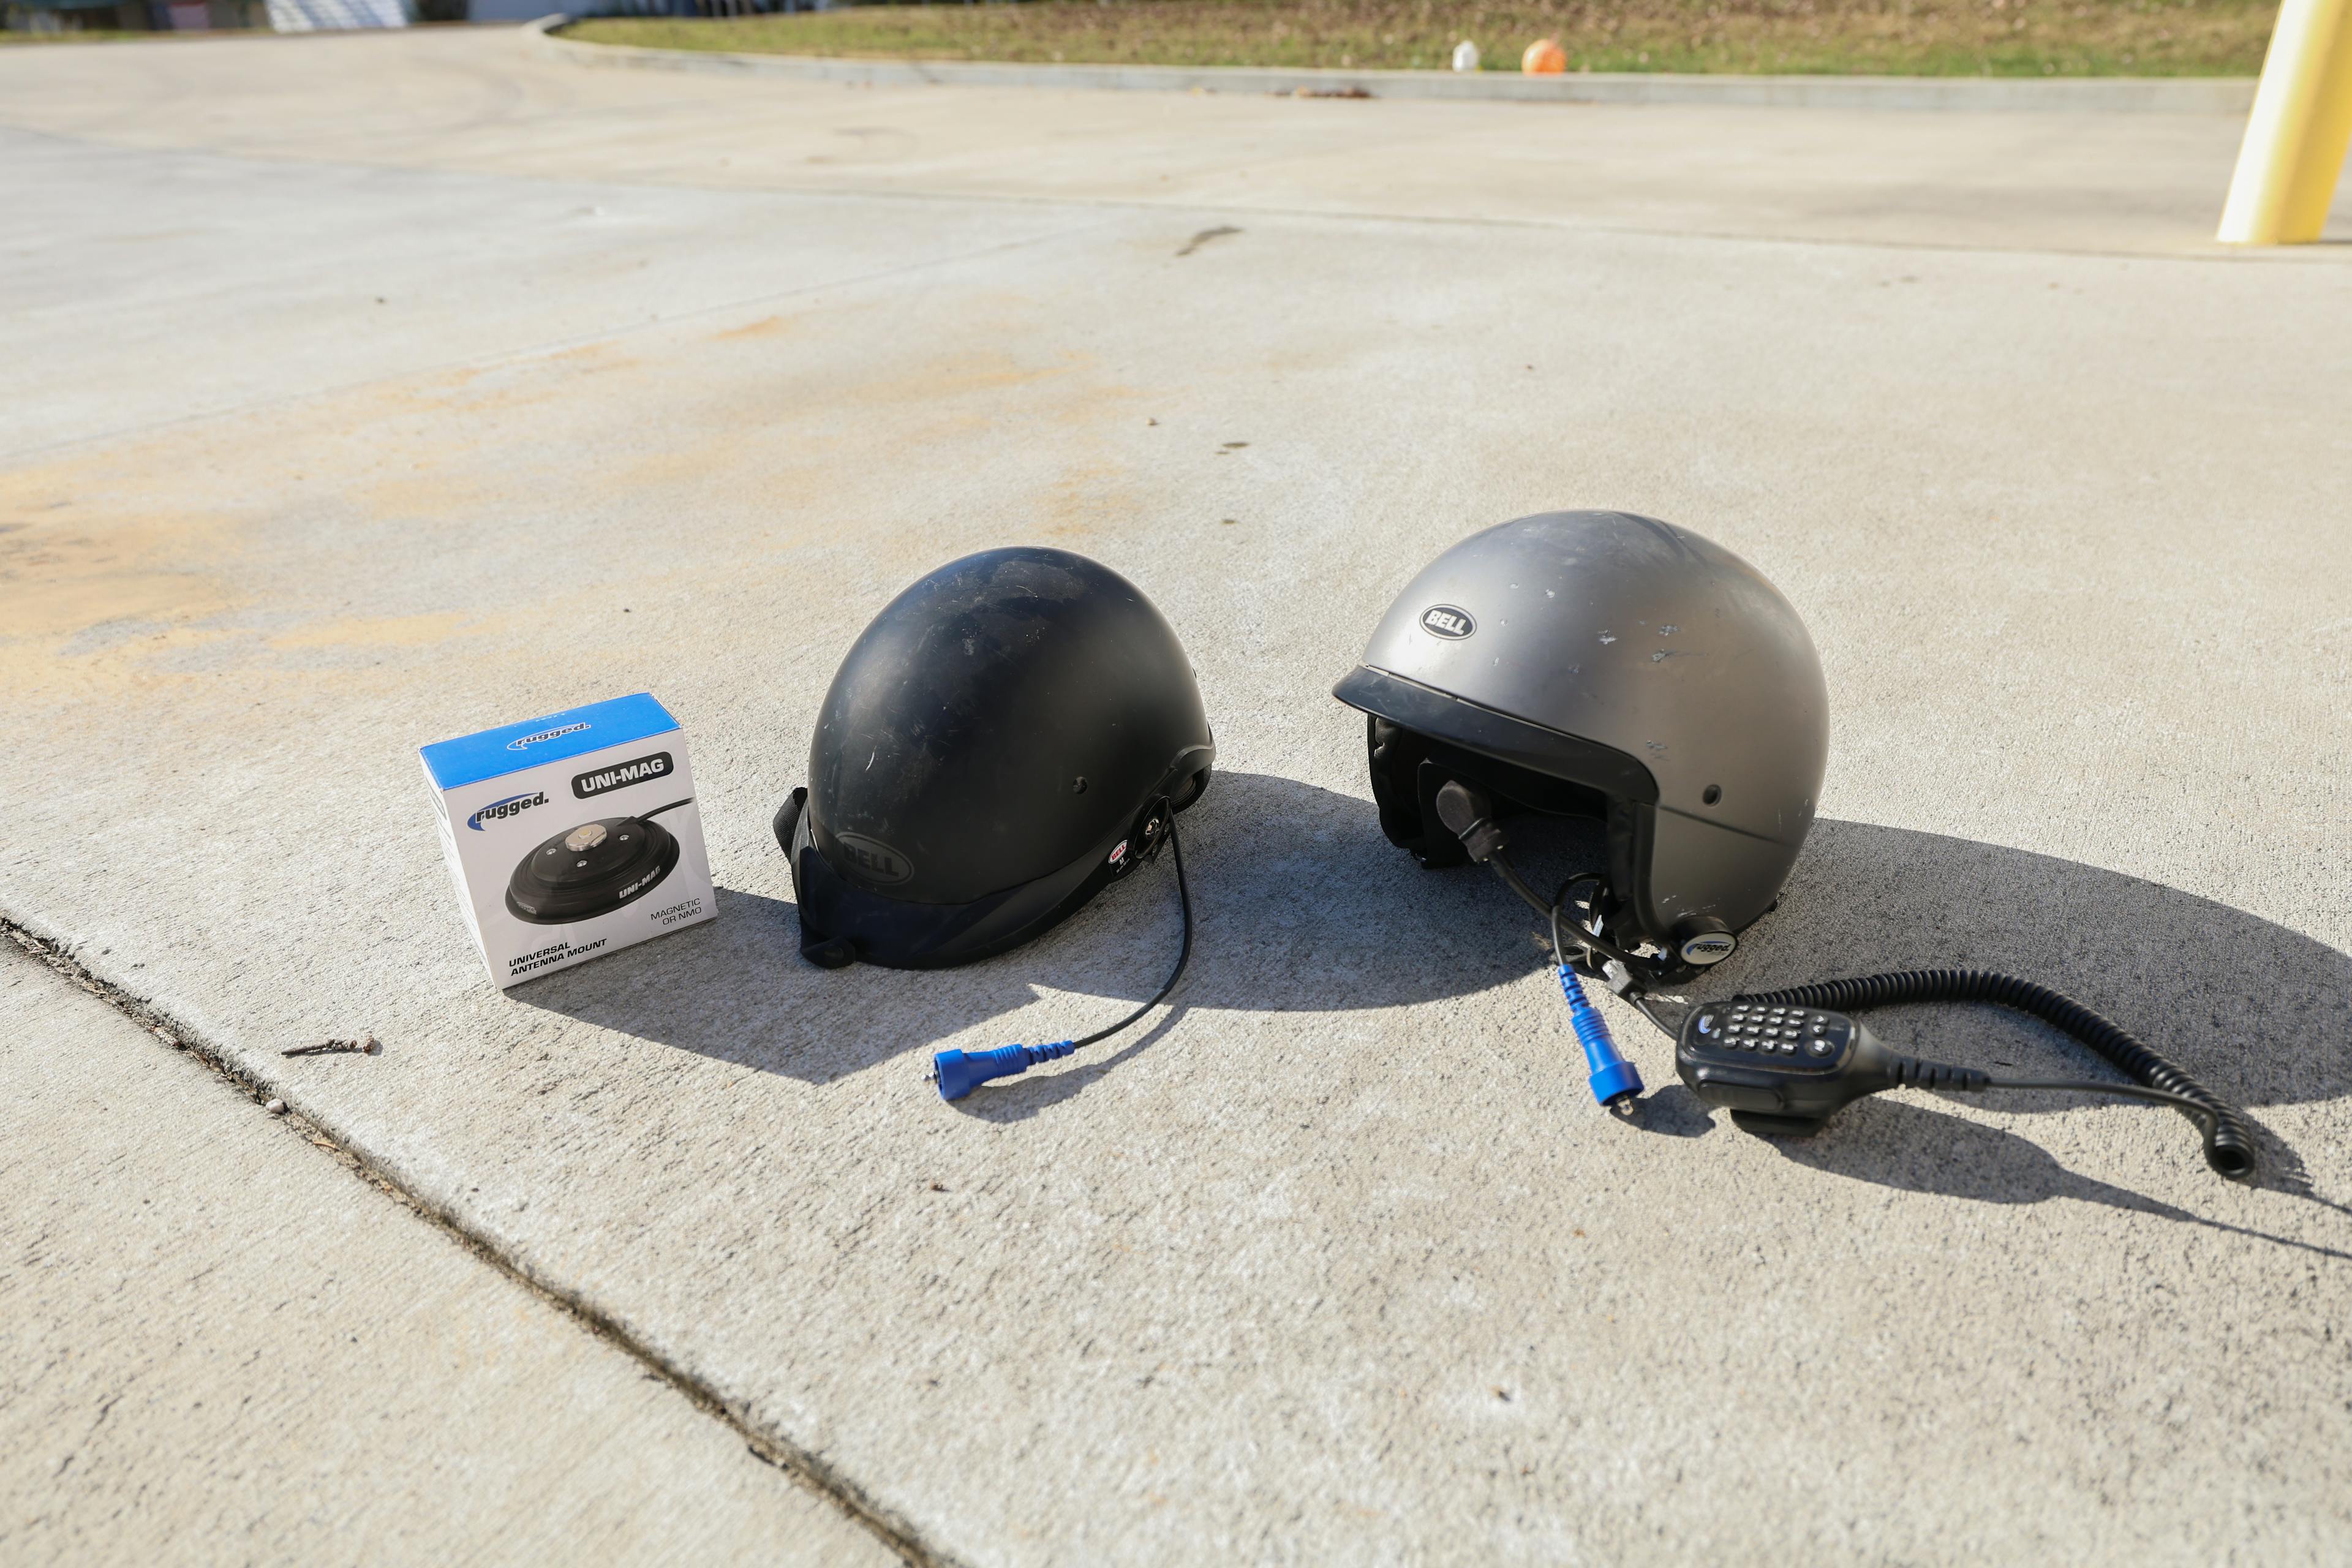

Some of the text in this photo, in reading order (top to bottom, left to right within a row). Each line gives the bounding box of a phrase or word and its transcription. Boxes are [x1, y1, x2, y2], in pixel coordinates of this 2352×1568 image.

[1425, 609, 1466, 636] BELL
[581, 758, 665, 793] UNI-MAG
[475, 791, 549, 823] rugged.
[843, 842, 899, 877] BELL
[1112, 845, 1126, 861] BELL
[619, 865, 662, 900] UNI-MAG
[650, 898, 701, 921] MAGNETIC
[662, 907, 702, 925] OR NMO
[508, 941, 571, 967] UNIVERSAL
[510, 938, 608, 976] ANTENNA MOUNT
